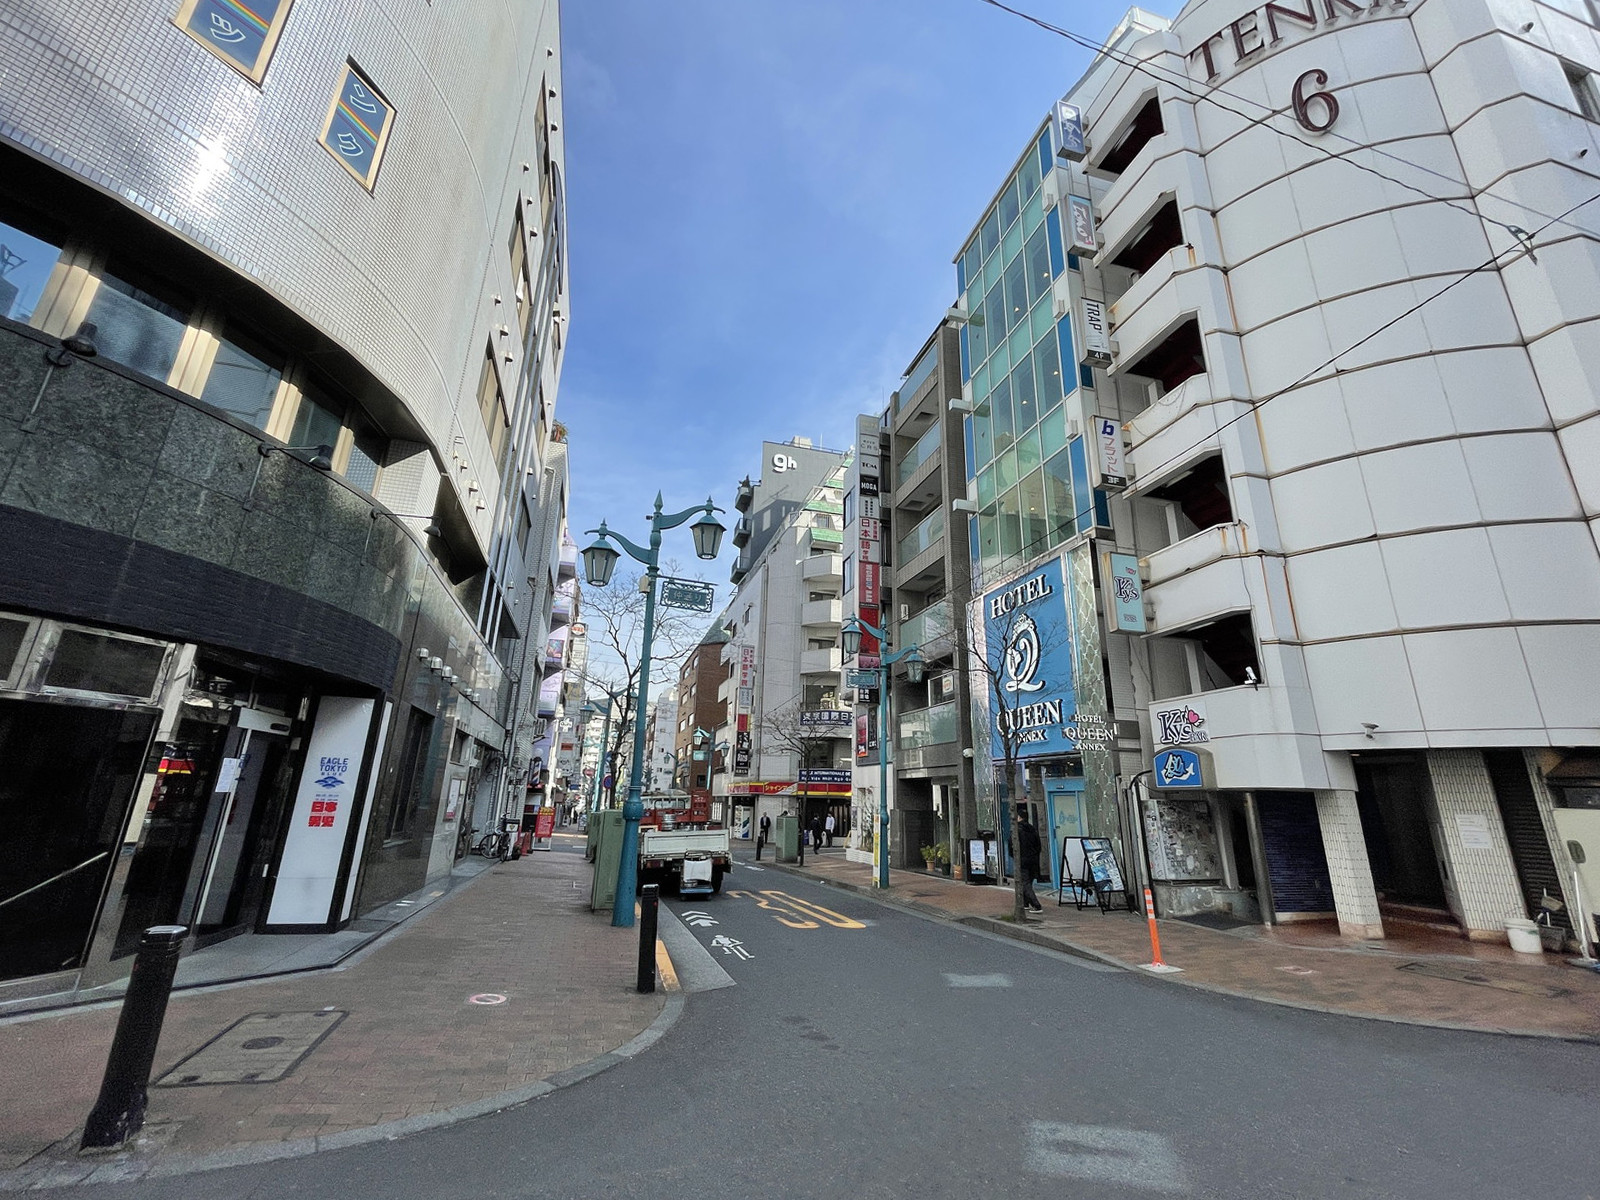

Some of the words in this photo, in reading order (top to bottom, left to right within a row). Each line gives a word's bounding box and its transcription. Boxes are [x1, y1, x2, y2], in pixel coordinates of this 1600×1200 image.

[1291, 68, 1340, 136] 6
[1107, 476, 1120, 485] 3F
[991, 574, 1052, 619] HOTEL
[996, 698, 1064, 739] QUEEN
[1074, 713, 1104, 723] HOTEL
[1063, 725, 1115, 742] QUEEN
[1075, 740, 1107, 752] ANNEX
[320, 757, 349, 765] EAGLE
[726, 889, 867, 930] 30
